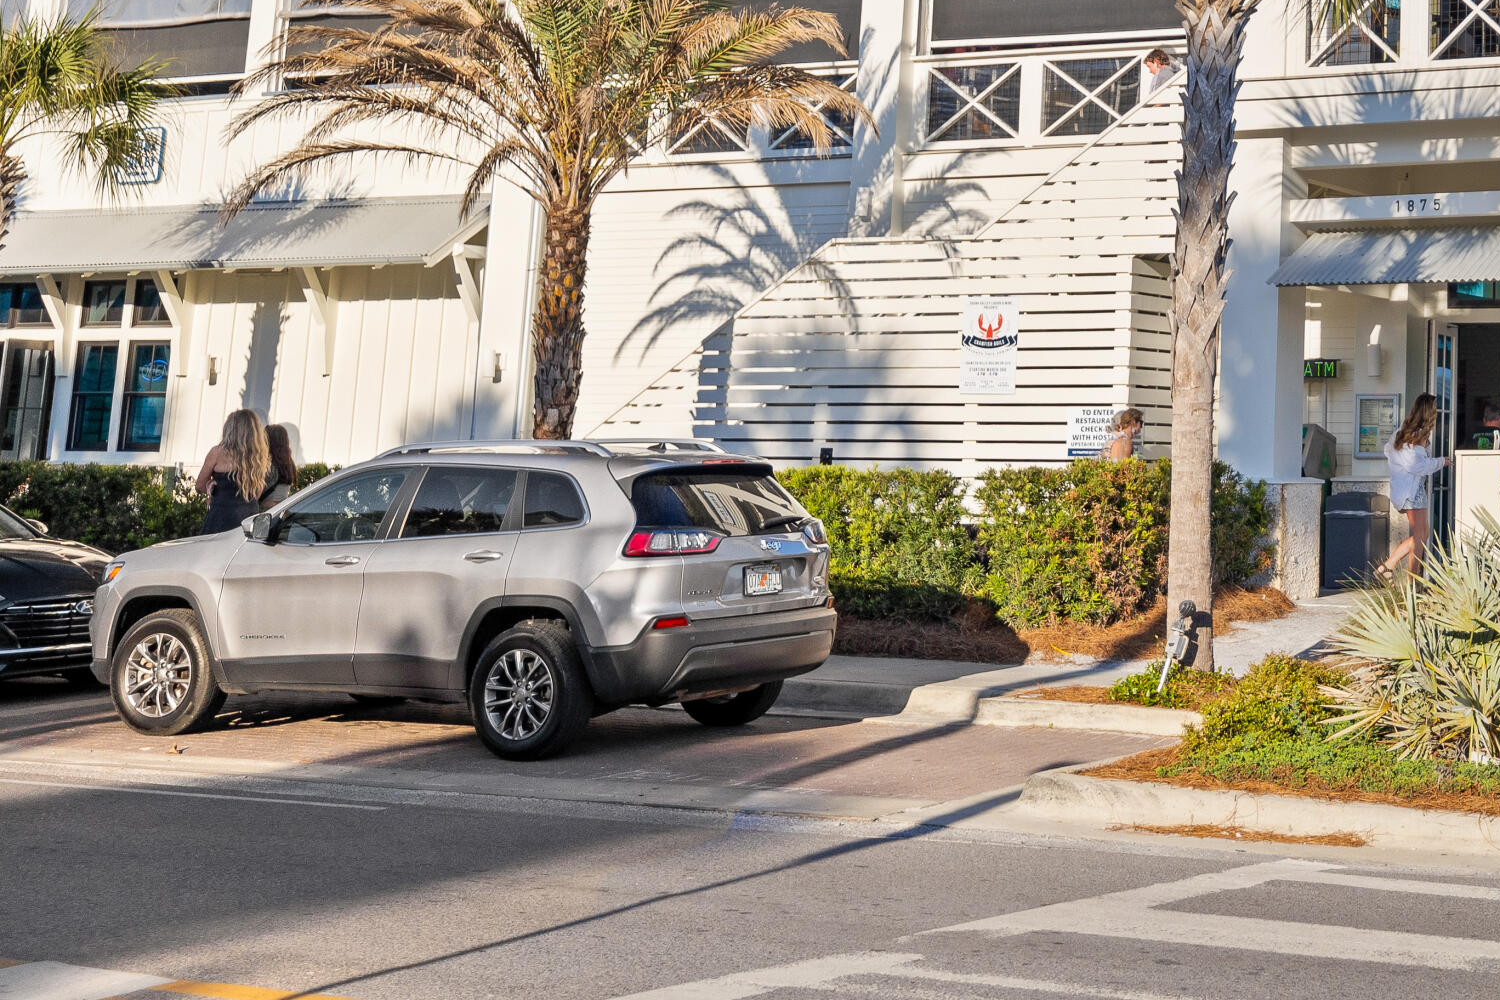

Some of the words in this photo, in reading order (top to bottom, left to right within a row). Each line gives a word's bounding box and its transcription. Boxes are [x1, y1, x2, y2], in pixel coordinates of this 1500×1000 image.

[1395, 198, 1441, 213] 1875
[142, 365, 168, 377] OPEN
[1303, 361, 1335, 377] ATM
[760, 539, 781, 551] Jeep
